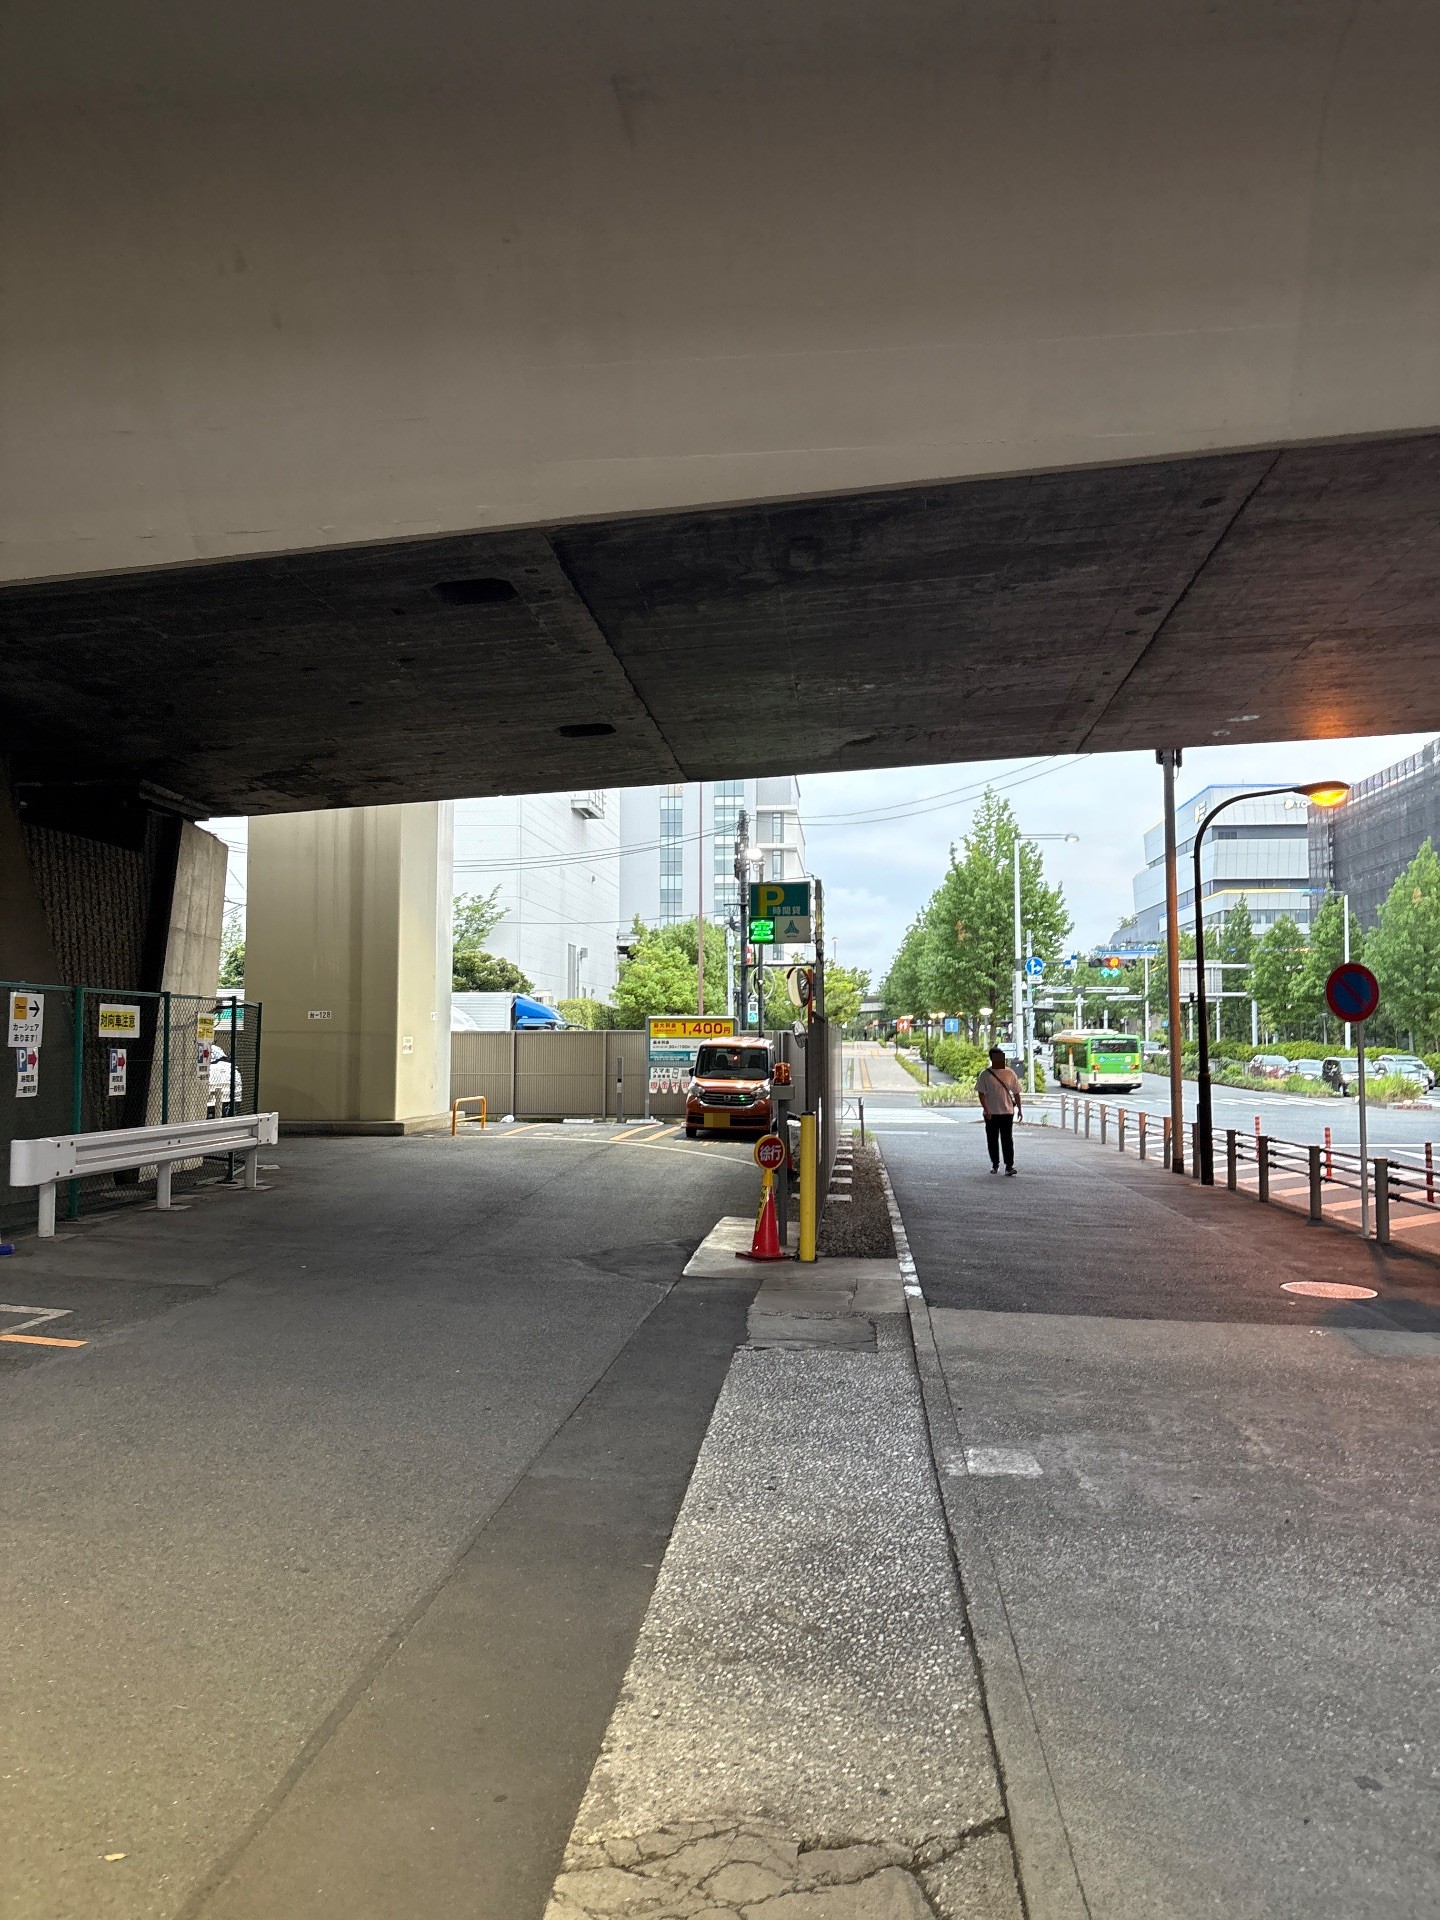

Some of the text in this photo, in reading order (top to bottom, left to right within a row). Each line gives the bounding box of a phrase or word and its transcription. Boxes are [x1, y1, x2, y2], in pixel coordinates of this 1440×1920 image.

[758, 885, 785, 917] P
[13, 1023, 40, 1031] カーシェア
[101, 1013, 136, 1028] 対向車注意
[19, 1049, 27, 1069] P
[111, 1052, 118, 1070] P
[760, 1144, 782, 1162] 徐行
